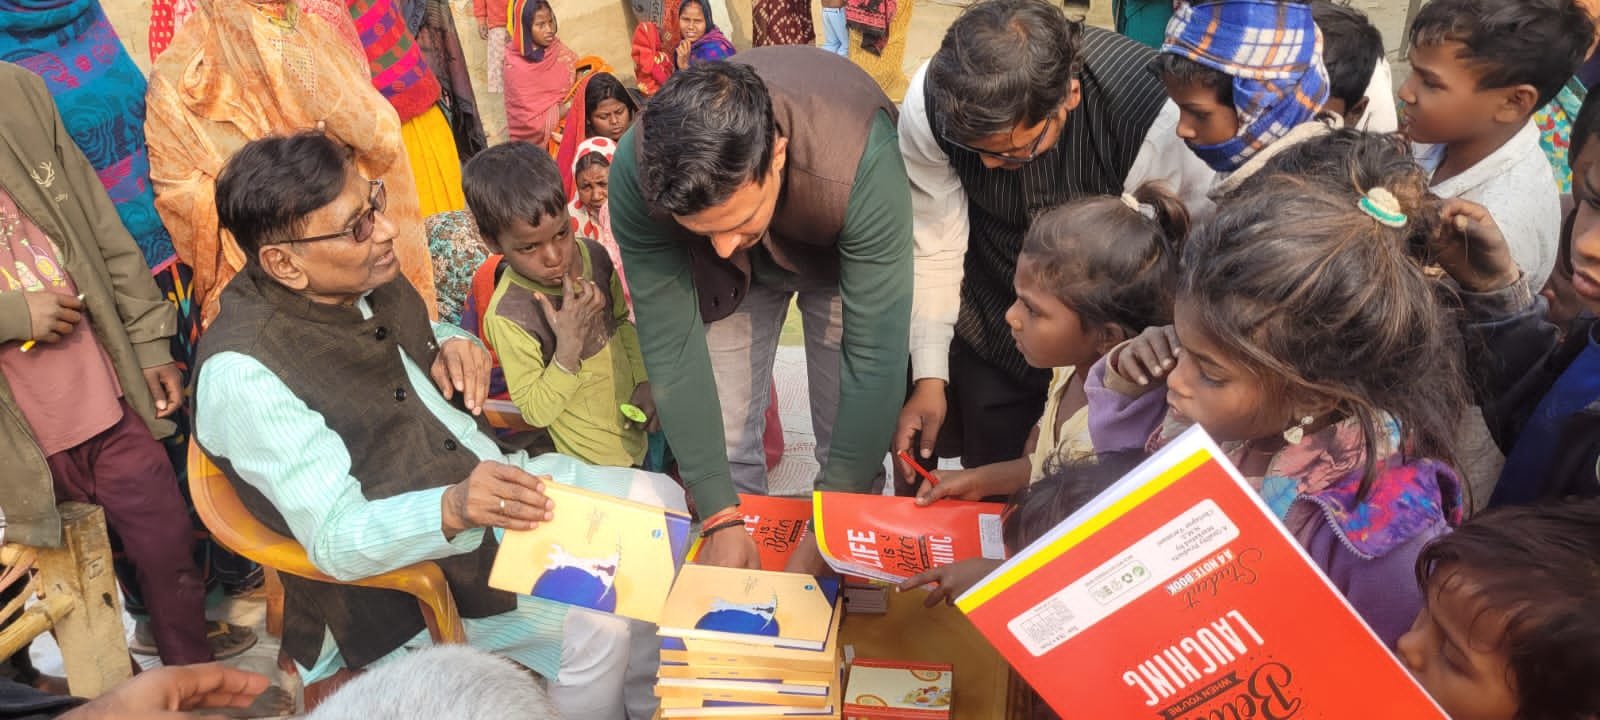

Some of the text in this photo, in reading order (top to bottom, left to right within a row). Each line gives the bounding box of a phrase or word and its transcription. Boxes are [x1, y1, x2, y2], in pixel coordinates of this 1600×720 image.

[847, 528, 883, 569] LIFE
[1166, 549, 1233, 596] A4 NOTE BOOK
[1122, 609, 1265, 707] LAUGHING
[1202, 677, 1234, 702] WHEN
